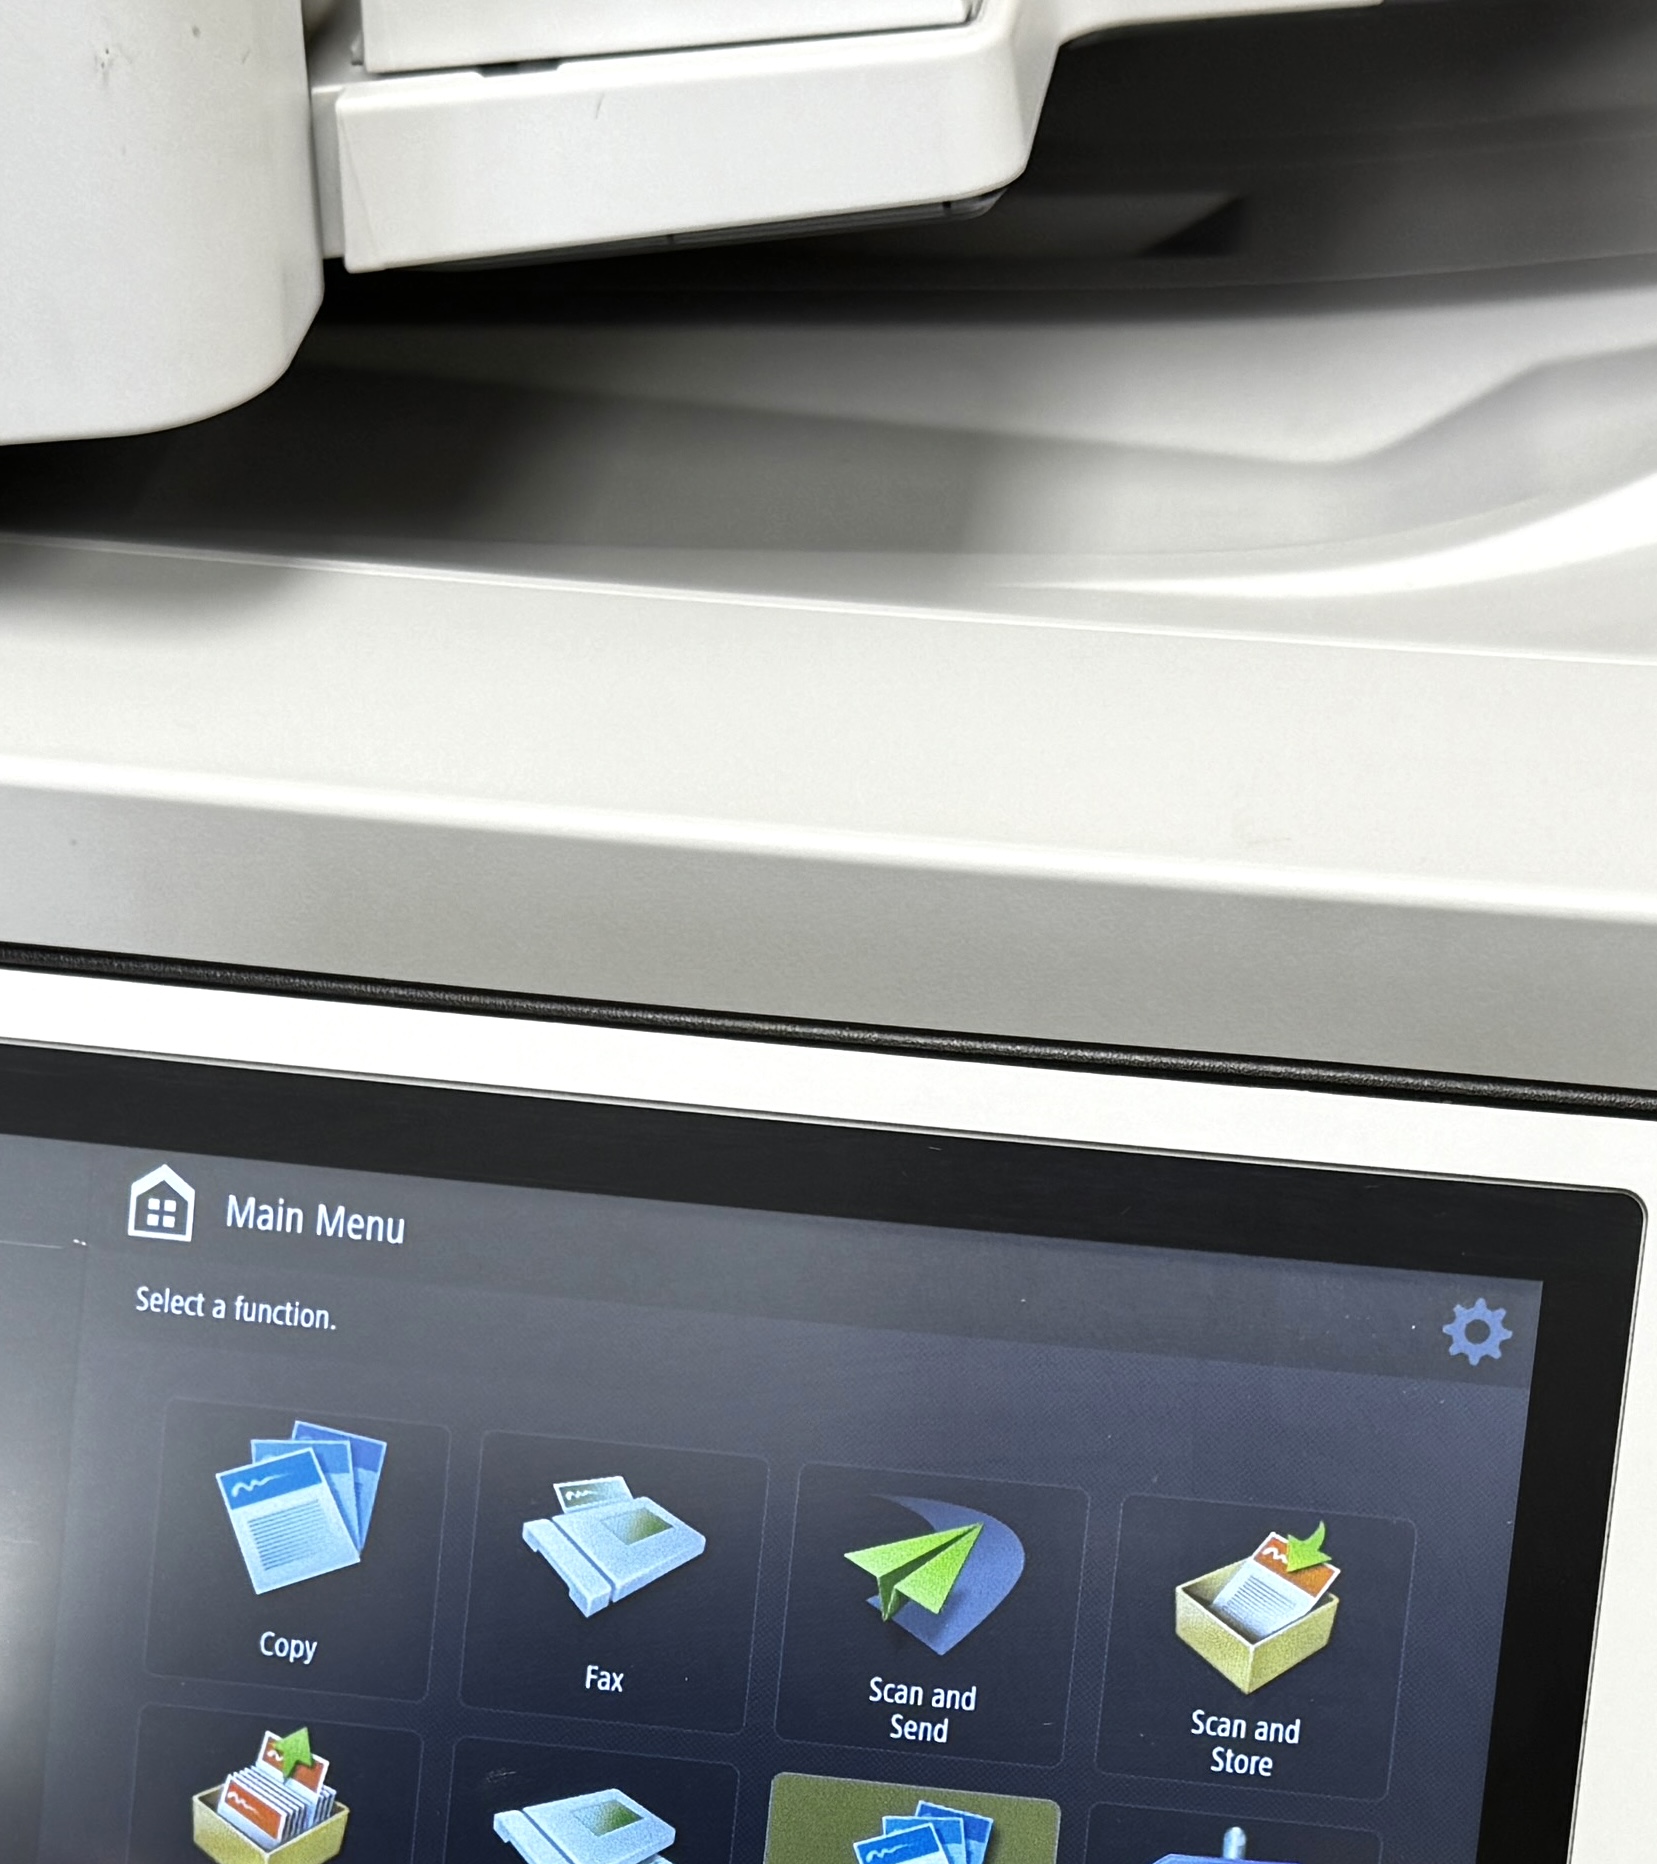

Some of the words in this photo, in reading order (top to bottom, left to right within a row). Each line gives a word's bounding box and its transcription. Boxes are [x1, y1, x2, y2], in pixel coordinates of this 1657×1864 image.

[226, 1193, 304, 1236] Main
[315, 1201, 406, 1245] Menu
[135, 1285, 205, 1318] Select
[211, 1297, 227, 1320] a
[231, 1294, 338, 1332] function.
[258, 1630, 319, 1667] Copy
[584, 1664, 624, 1694] Fax
[868, 1676, 924, 1707] Scan
[930, 1683, 977, 1712] and
[889, 1713, 950, 1744] Send
[1190, 1709, 1247, 1739] Scan
[1254, 1716, 1301, 1745] and
[1210, 1747, 1274, 1777] Store
